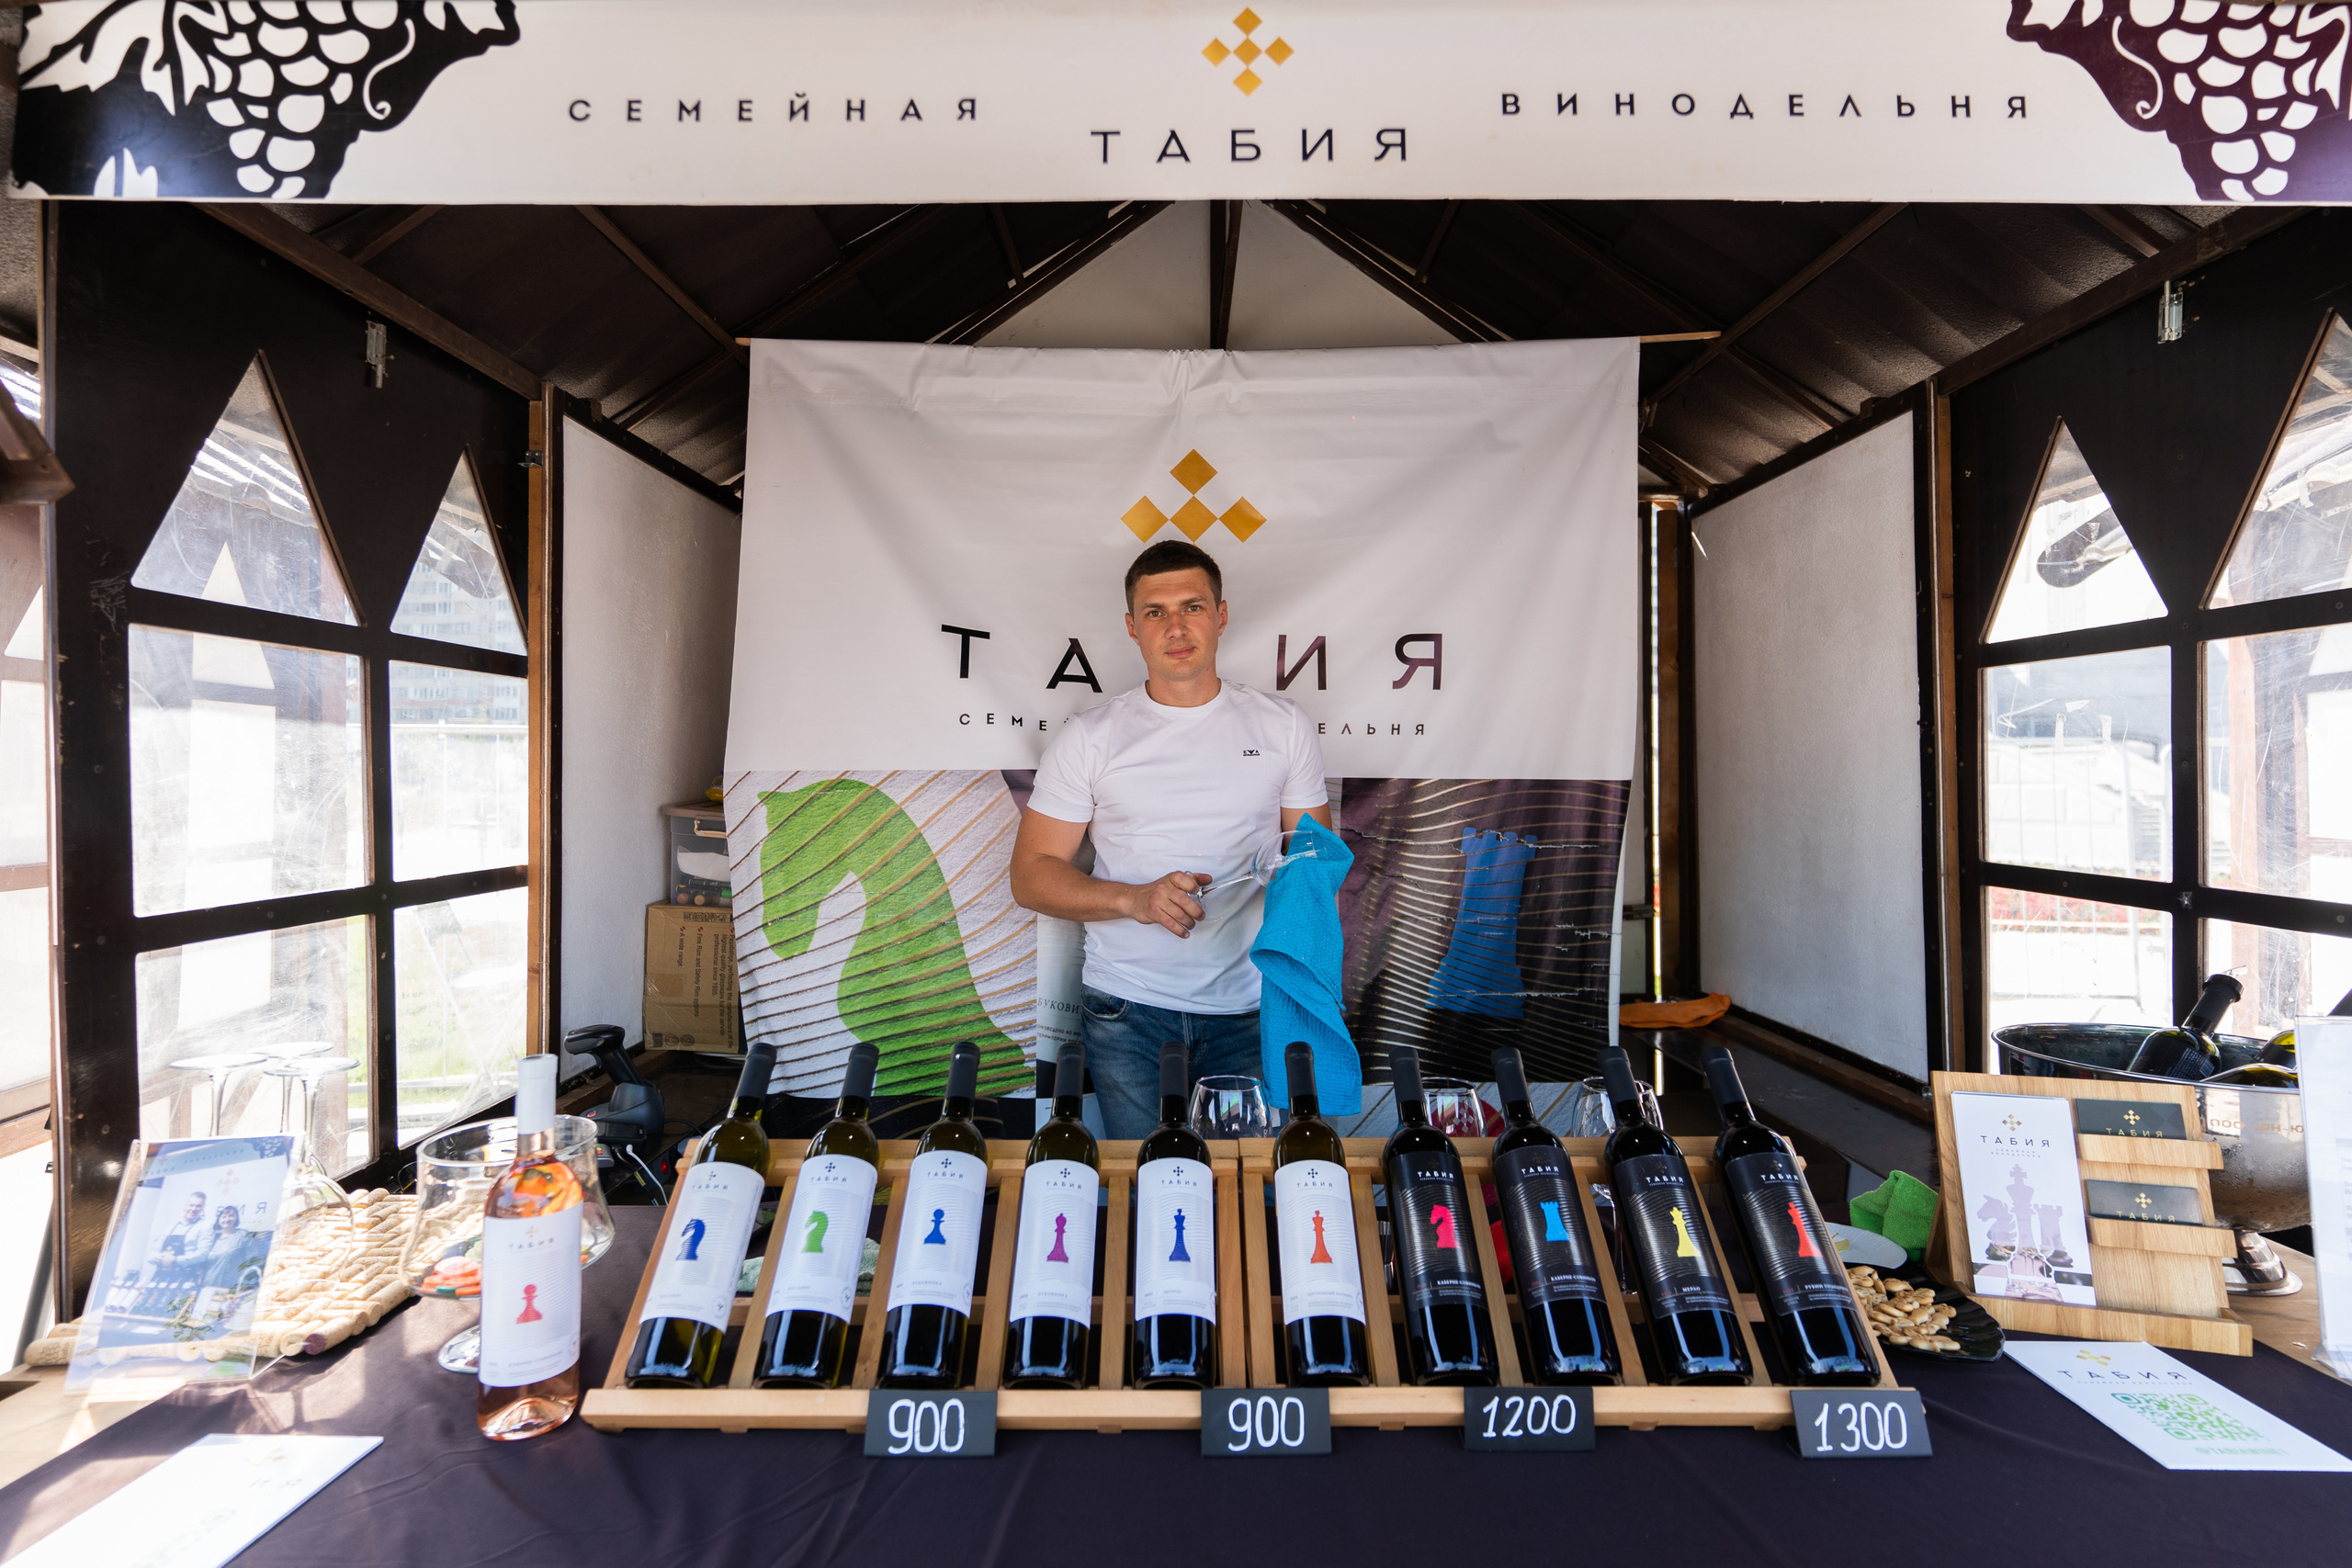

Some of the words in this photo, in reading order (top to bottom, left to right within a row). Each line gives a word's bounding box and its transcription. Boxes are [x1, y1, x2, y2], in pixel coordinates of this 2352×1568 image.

[568, 92, 978, 122] СЕМЕЙНАЯ
[1500, 92, 2028, 120] ВИНОДЕЛЬНЯ
[1090, 128, 1408, 164] ТАБИЯ
[941, 623, 1443, 694] ТАИЯ
[958, 713, 1069, 731] СЕМЕ
[1317, 722, 1425, 736] ЕЛЬНЯ
[1037, 997, 1080, 1014] БУКОВИ
[2105, 1127, 2164, 1138] ТАБИЯ
[1980, 1134, 2051, 1147] ТАБИЯ
[926, 1171, 964, 1179] ТАБИЯ
[1417, 1169, 1454, 1180] ТАБИЯ
[1521, 1165, 1559, 1176] ТАБИЯ
[1645, 1175, 1684, 1184] ТАБИЯ
[1759, 1172, 1800, 1182] ТАБИЯ
[1046, 1180, 1082, 1190] ТАБИЯ
[1161, 1179, 1197, 1188] ТАБИЯ
[1296, 1180, 1333, 1189] ТАБИЯ
[2116, 1211, 2176, 1223] ТАБИЯ
[2057, 1370, 2188, 1380] ТАБИЯ
[1482, 1393, 1577, 1438] 1200
[888, 1398, 966, 1455] 900
[1227, 1395, 1306, 1453] 900
[1815, 1400, 1907, 1454] 1300
